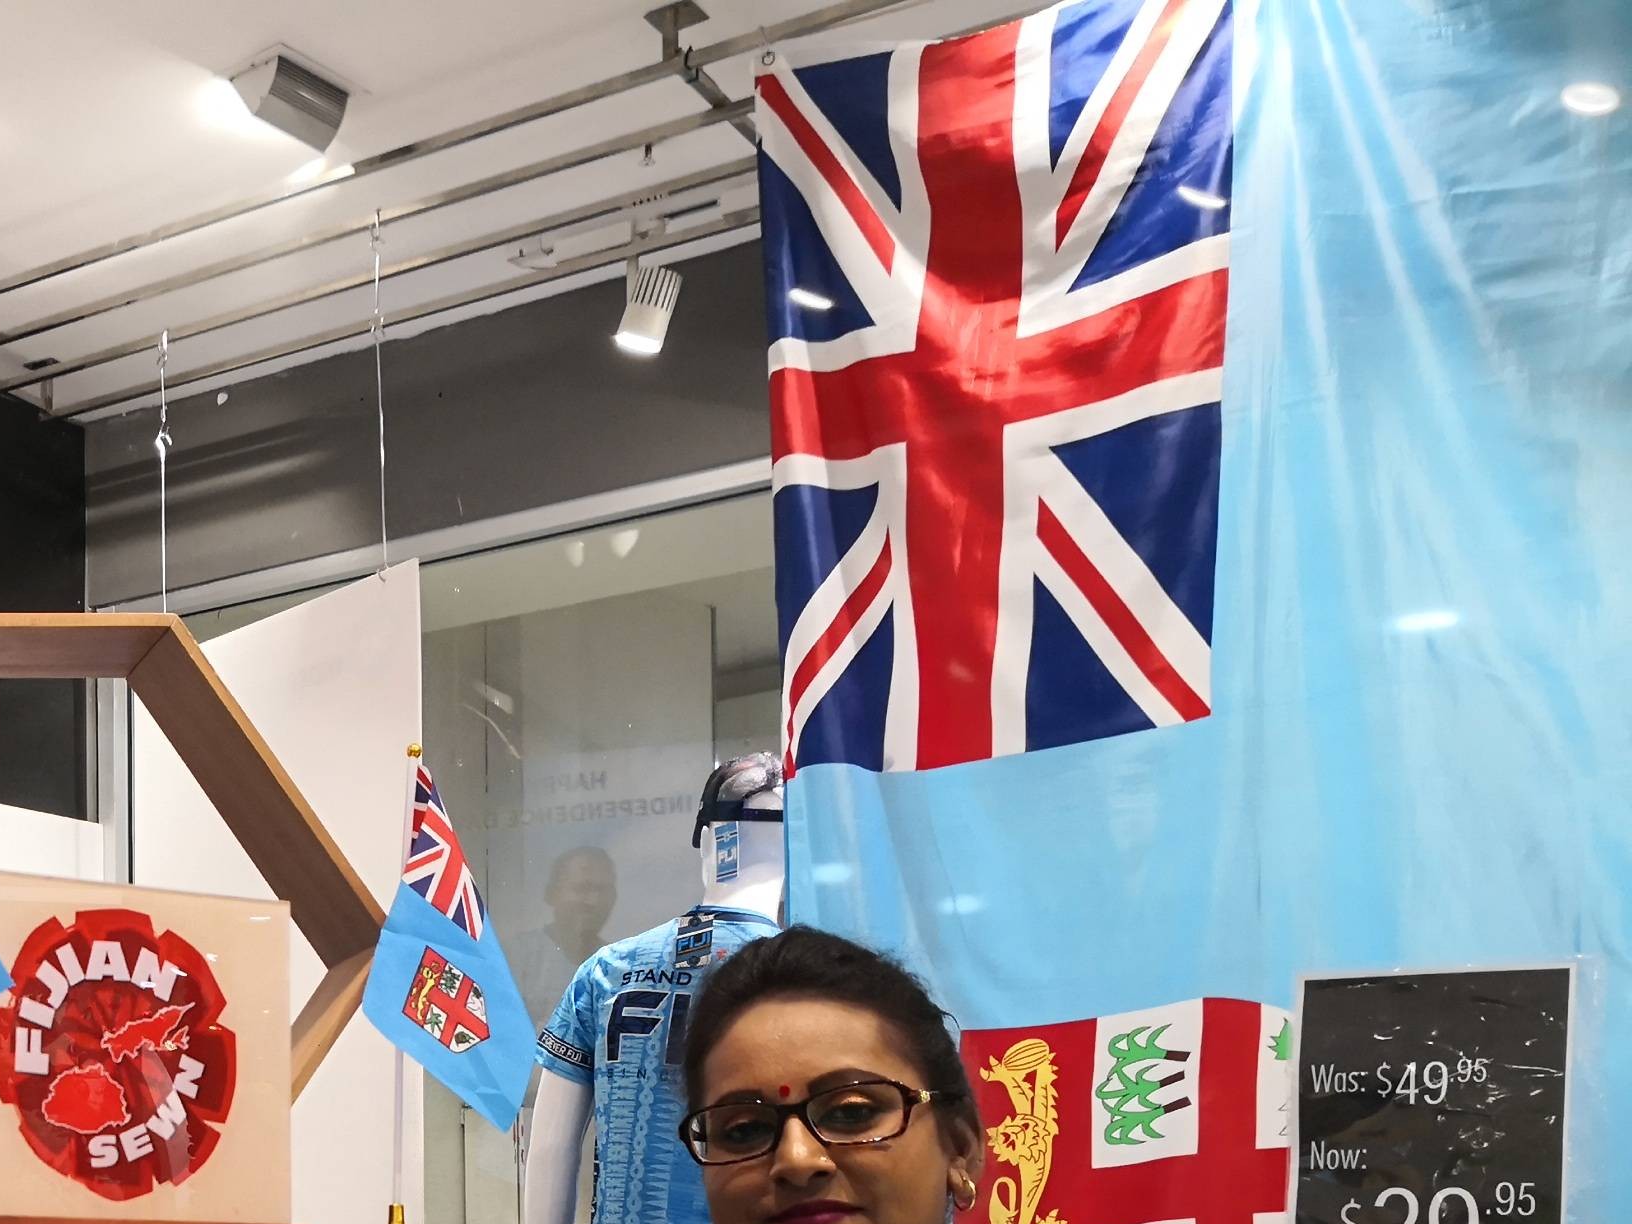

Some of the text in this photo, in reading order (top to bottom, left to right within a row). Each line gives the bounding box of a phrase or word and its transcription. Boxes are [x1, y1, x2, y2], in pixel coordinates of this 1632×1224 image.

[677, 931, 711, 952] FIJI
[621, 969, 693, 986] STAND
[14, 940, 178, 1076] FIJIAN
[606, 989, 692, 1065] FI
[1311, 1063, 1366, 1094] Was:
[88, 1053, 205, 1169] SEWN
[1310, 1140, 1367, 1170] Now:
